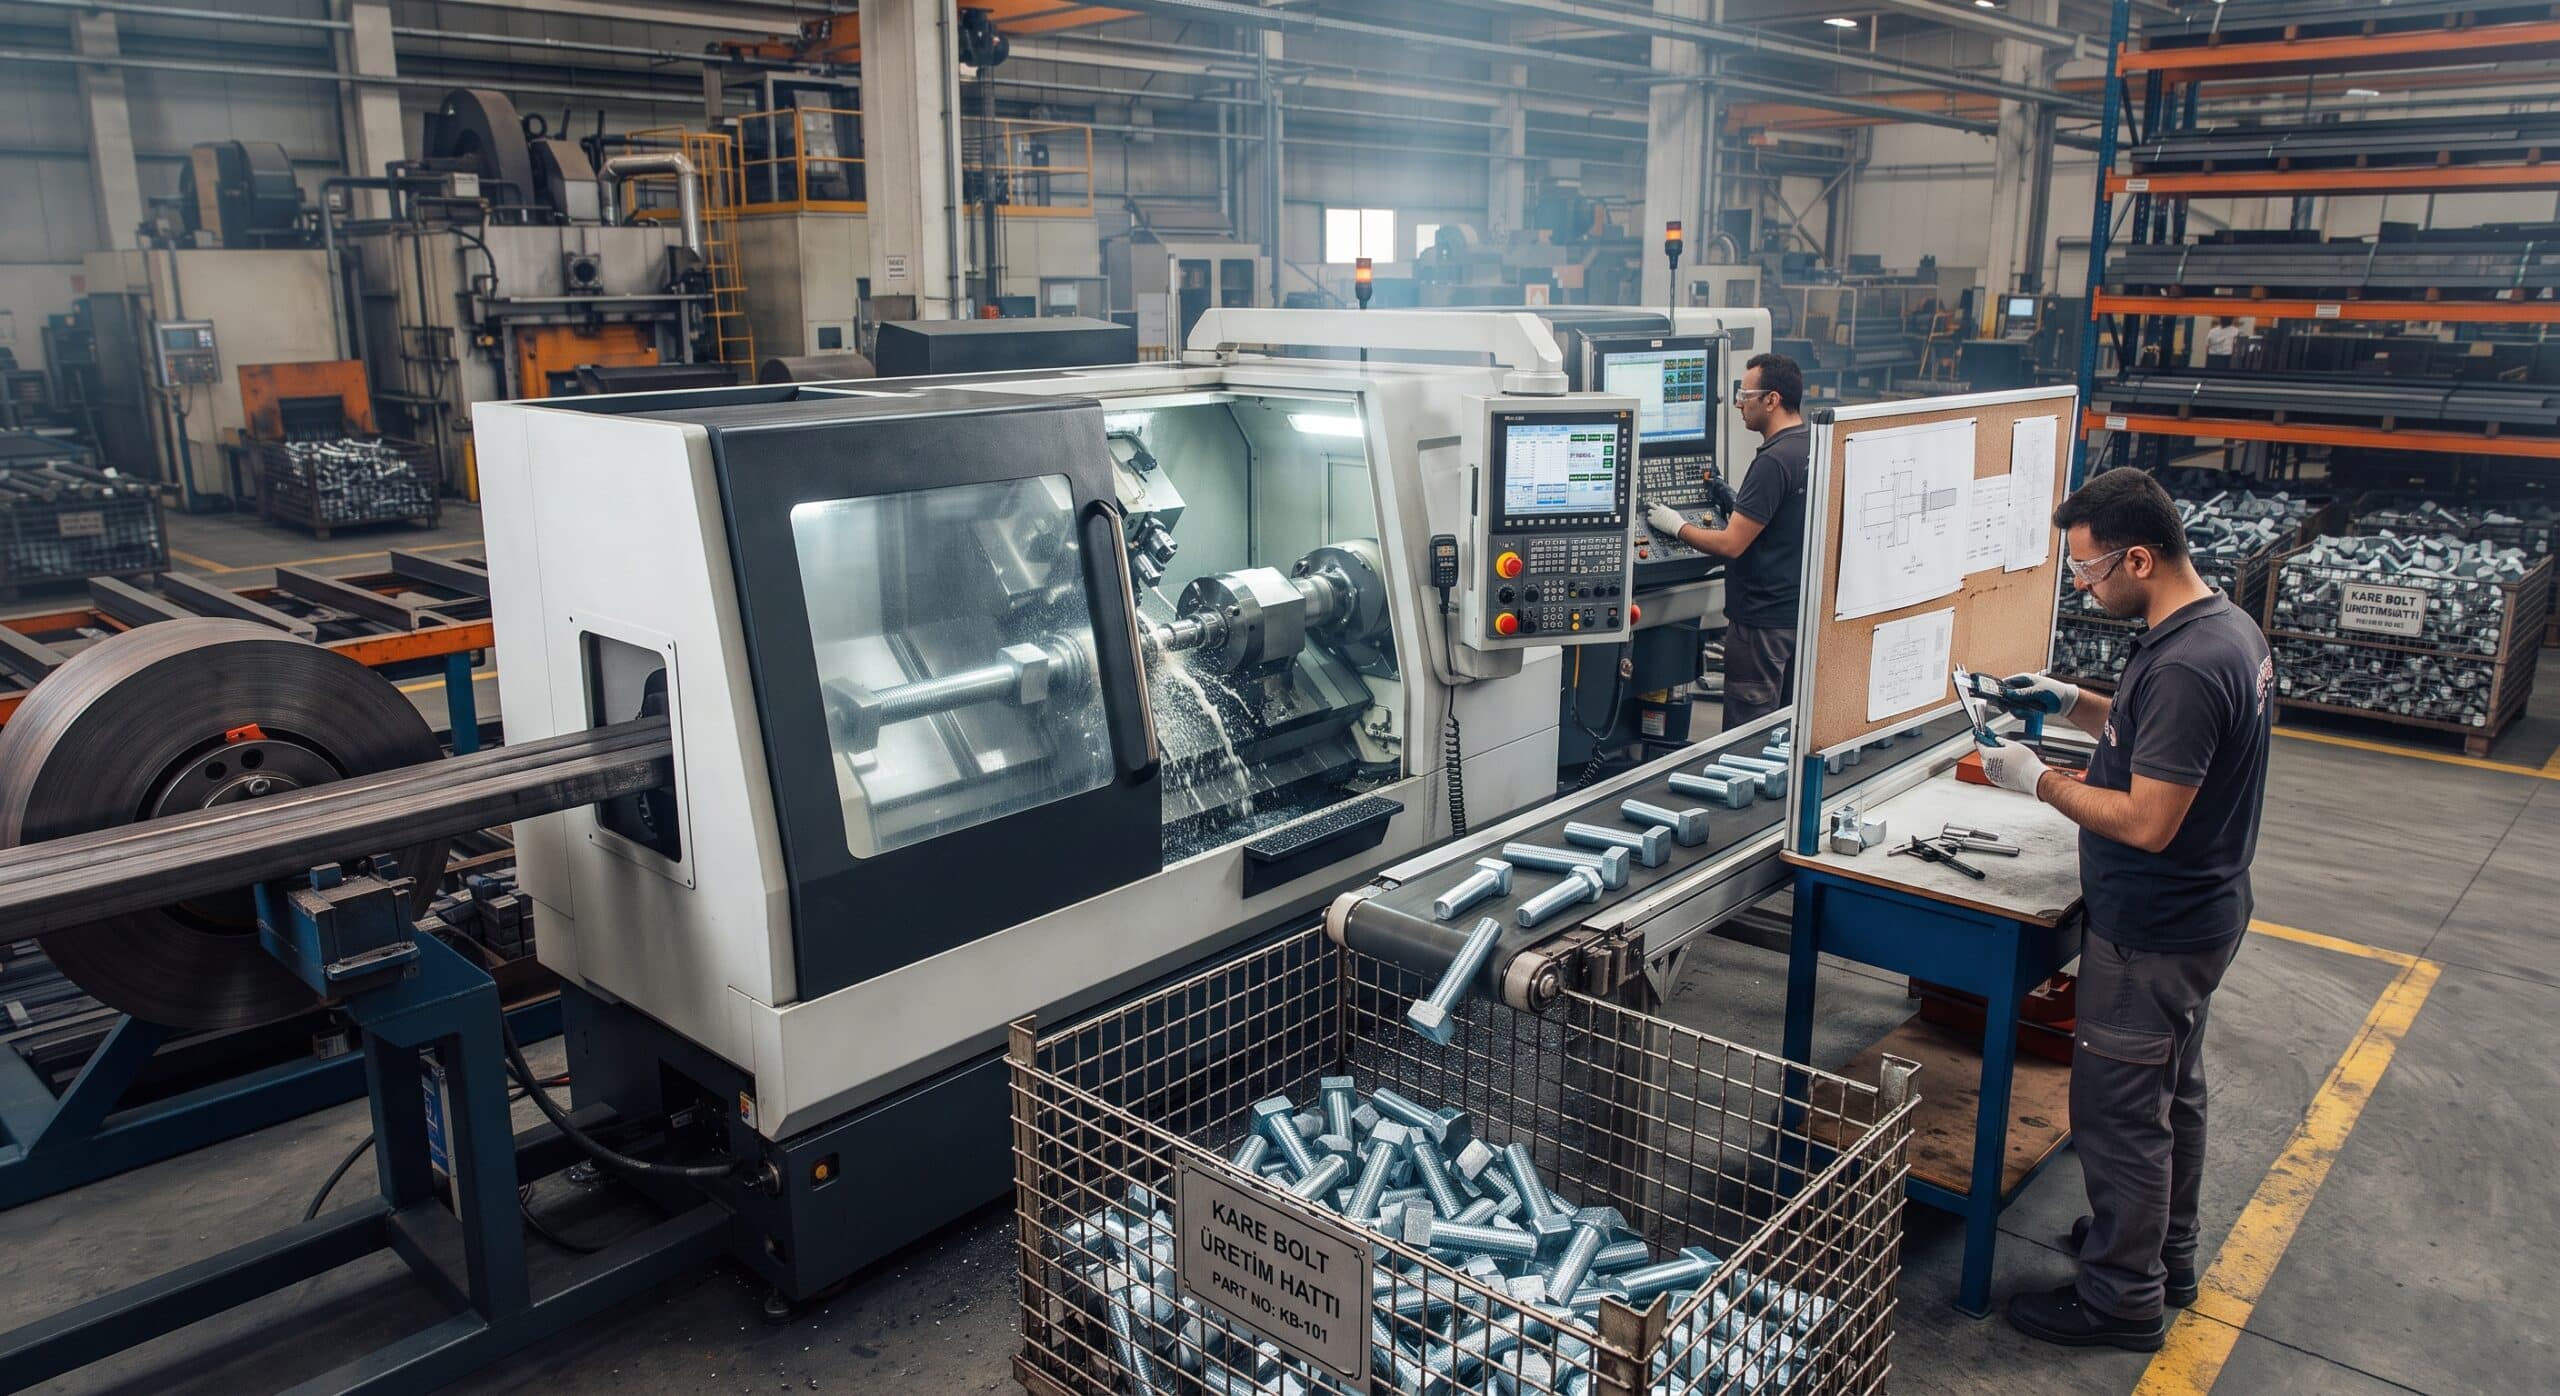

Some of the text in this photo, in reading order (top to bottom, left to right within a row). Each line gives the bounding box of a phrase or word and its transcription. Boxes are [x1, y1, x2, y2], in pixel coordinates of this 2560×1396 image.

[2351, 591, 2416, 607] KARE BOLT
[1201, 1225, 1340, 1319] ÜRETİM HATTI
[1212, 1200, 1329, 1274] KARE BOLT
[1212, 1271, 1328, 1344] PART NO: KB-101
